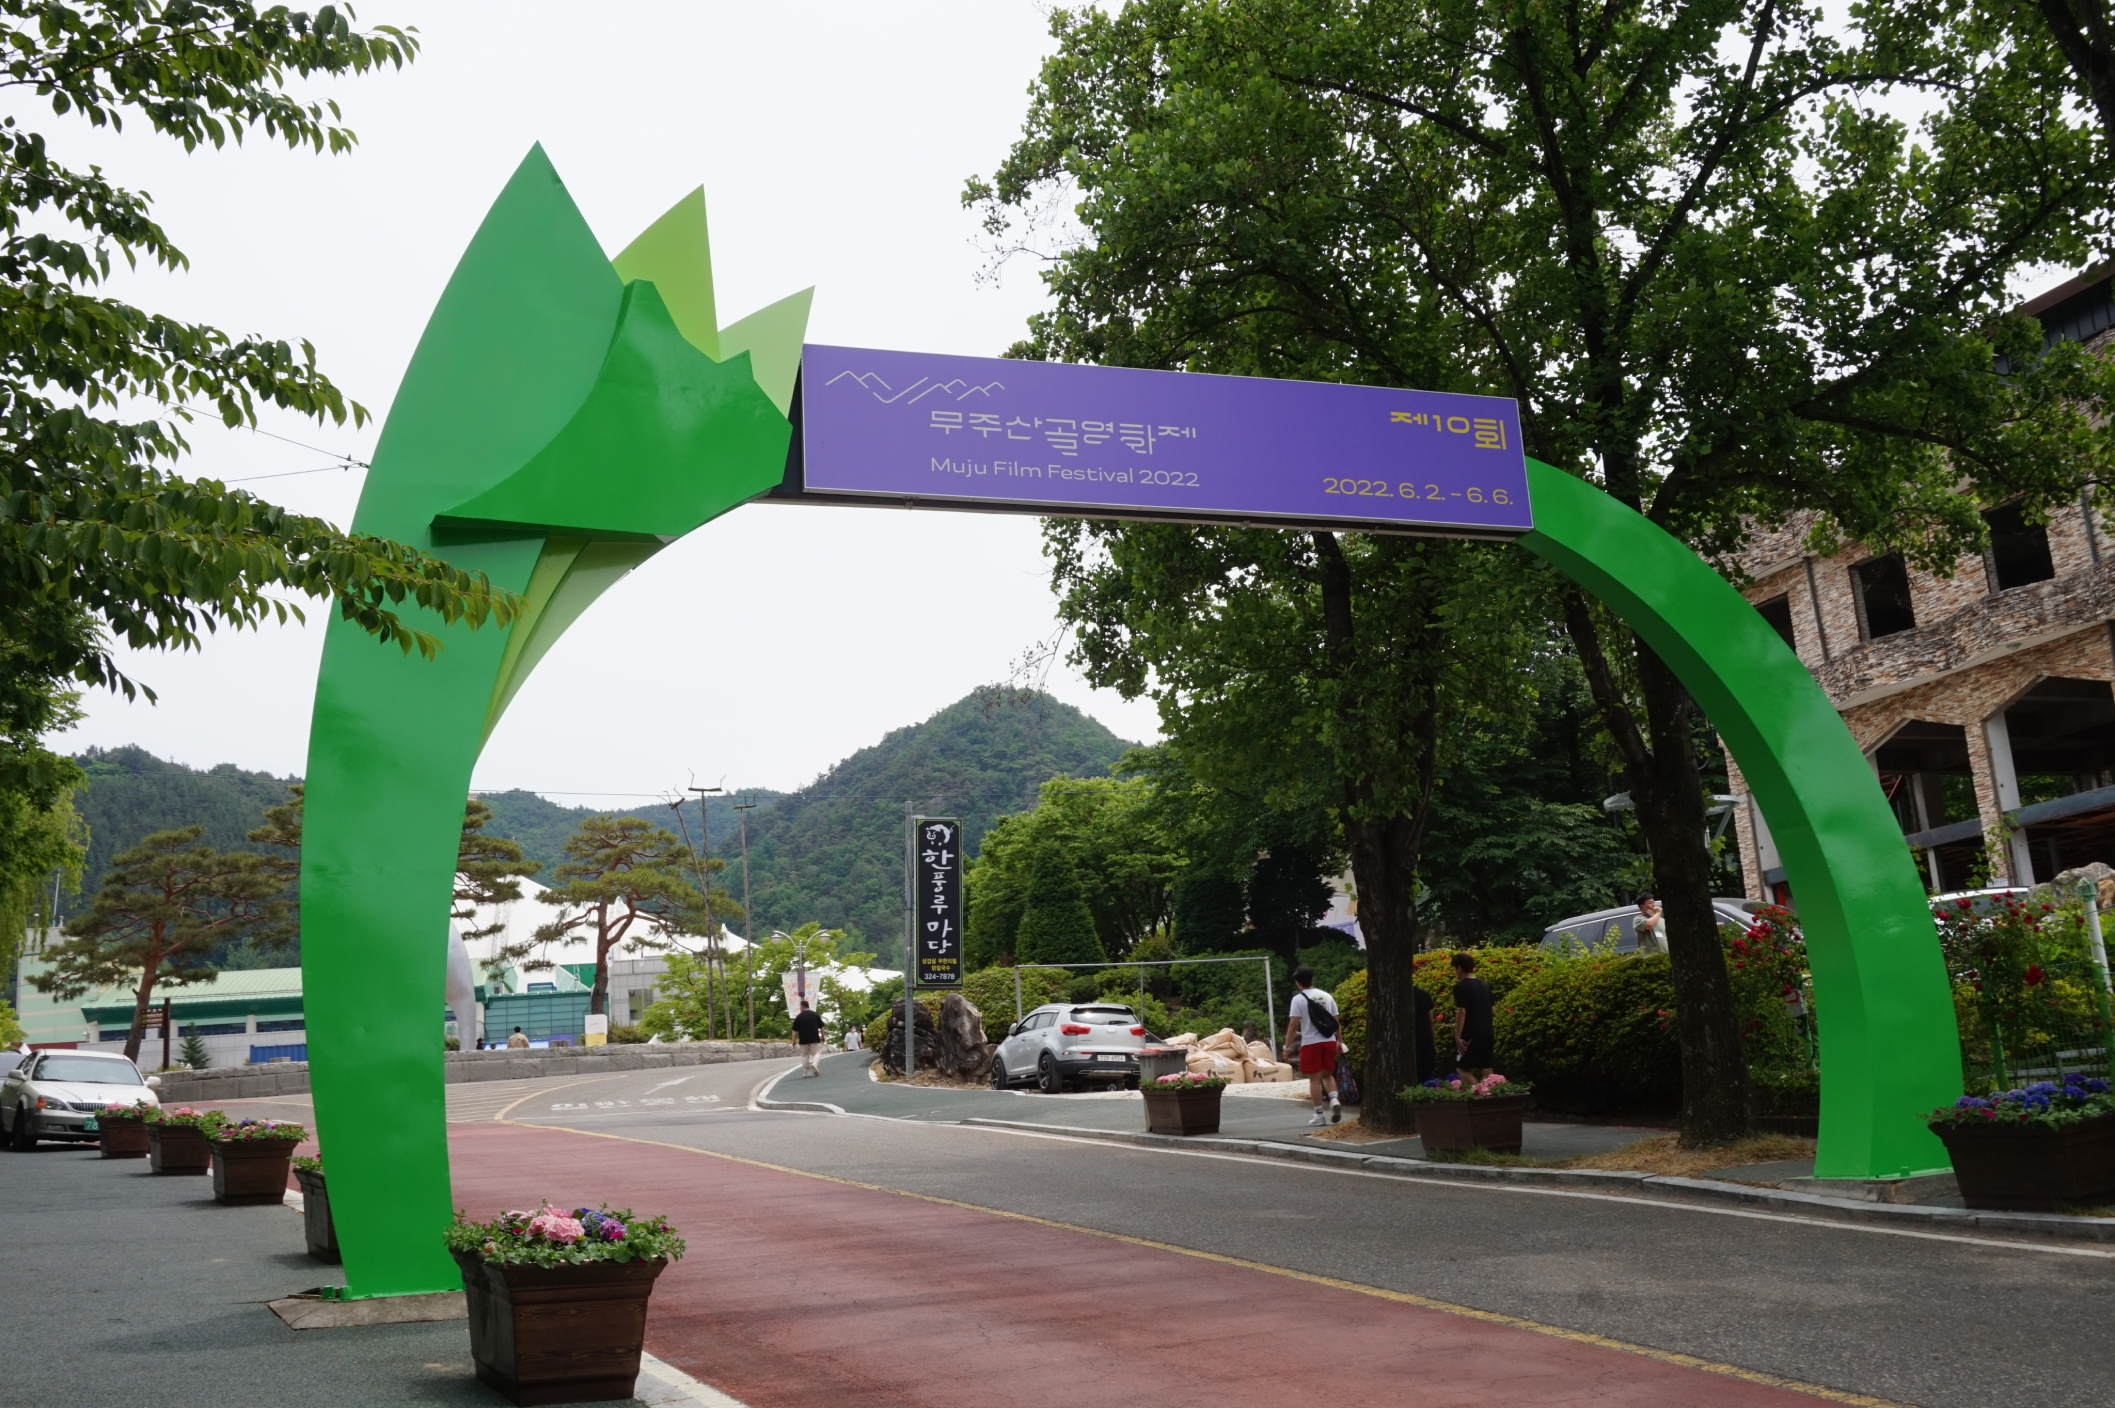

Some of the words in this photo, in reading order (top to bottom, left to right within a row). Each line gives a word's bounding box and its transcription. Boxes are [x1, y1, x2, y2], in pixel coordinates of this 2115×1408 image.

[930, 411, 1197, 456] 무주산골영화제
[1390, 411, 1507, 450] 제10회
[931, 457, 987, 478] Muju
[993, 461, 1042, 478] Film
[1047, 464, 1134, 483] Festival
[1139, 469, 1200, 487] 2022
